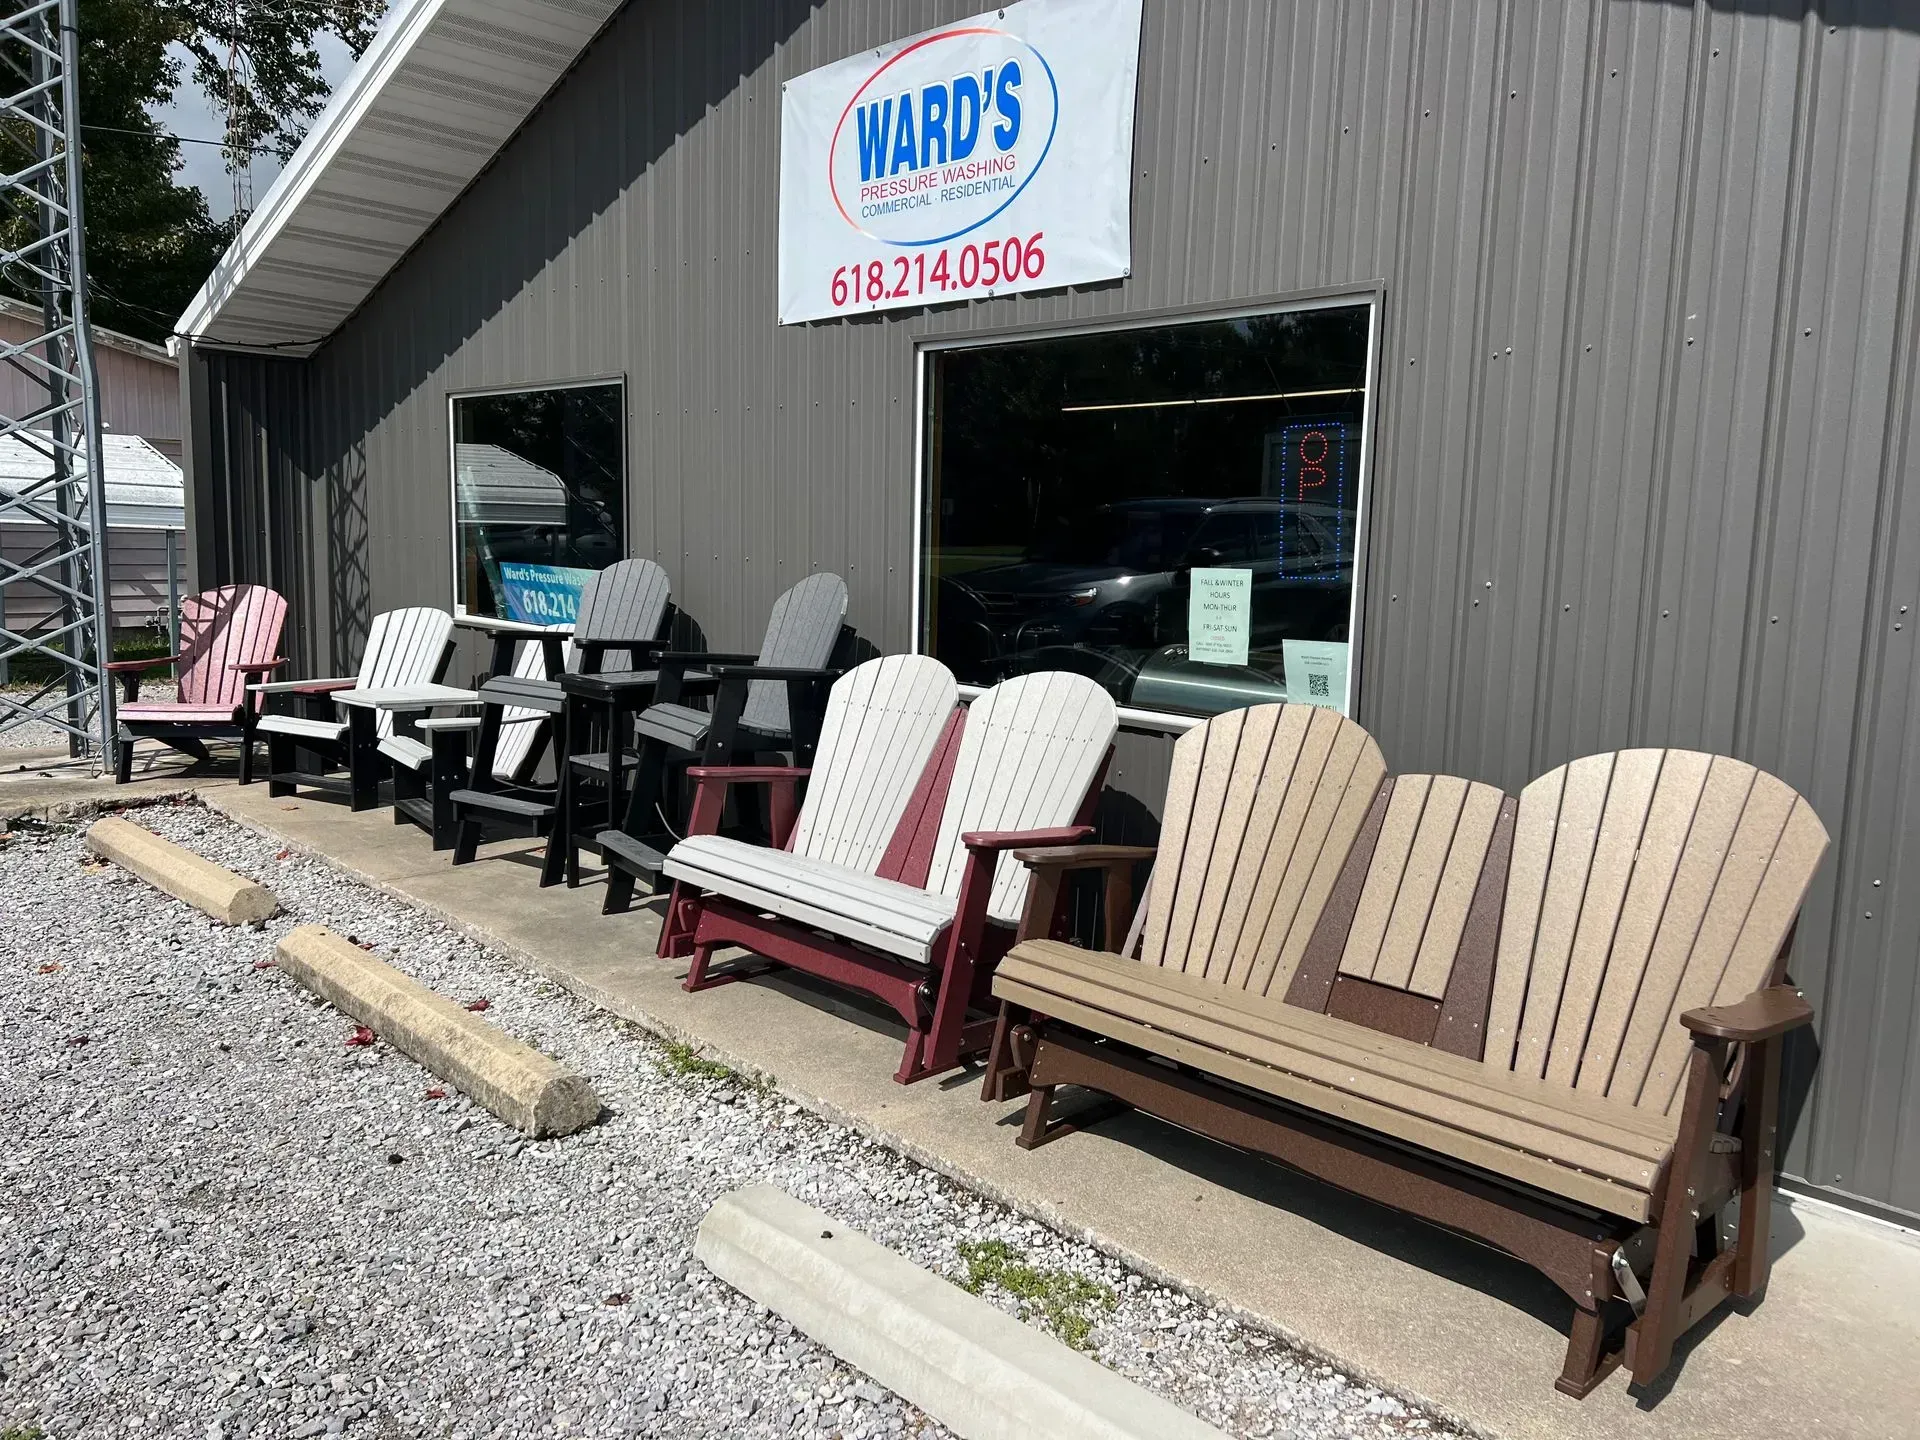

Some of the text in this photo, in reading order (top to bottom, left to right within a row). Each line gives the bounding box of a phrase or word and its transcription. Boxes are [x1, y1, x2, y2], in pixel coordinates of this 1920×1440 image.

[855, 59, 1023, 183] WARD'S
[861, 154, 1016, 203] PRESSURE WASHING
[861, 174, 1016, 218] COMMERCIAL RESIDENTIAL
[831, 232, 1045, 307] 618.214.0506
[503, 566, 530, 582] Ward's
[530, 569, 564, 585] Pressure
[1200, 578, 1213, 586] FALL
[1209, 591, 1231, 599] HOURS
